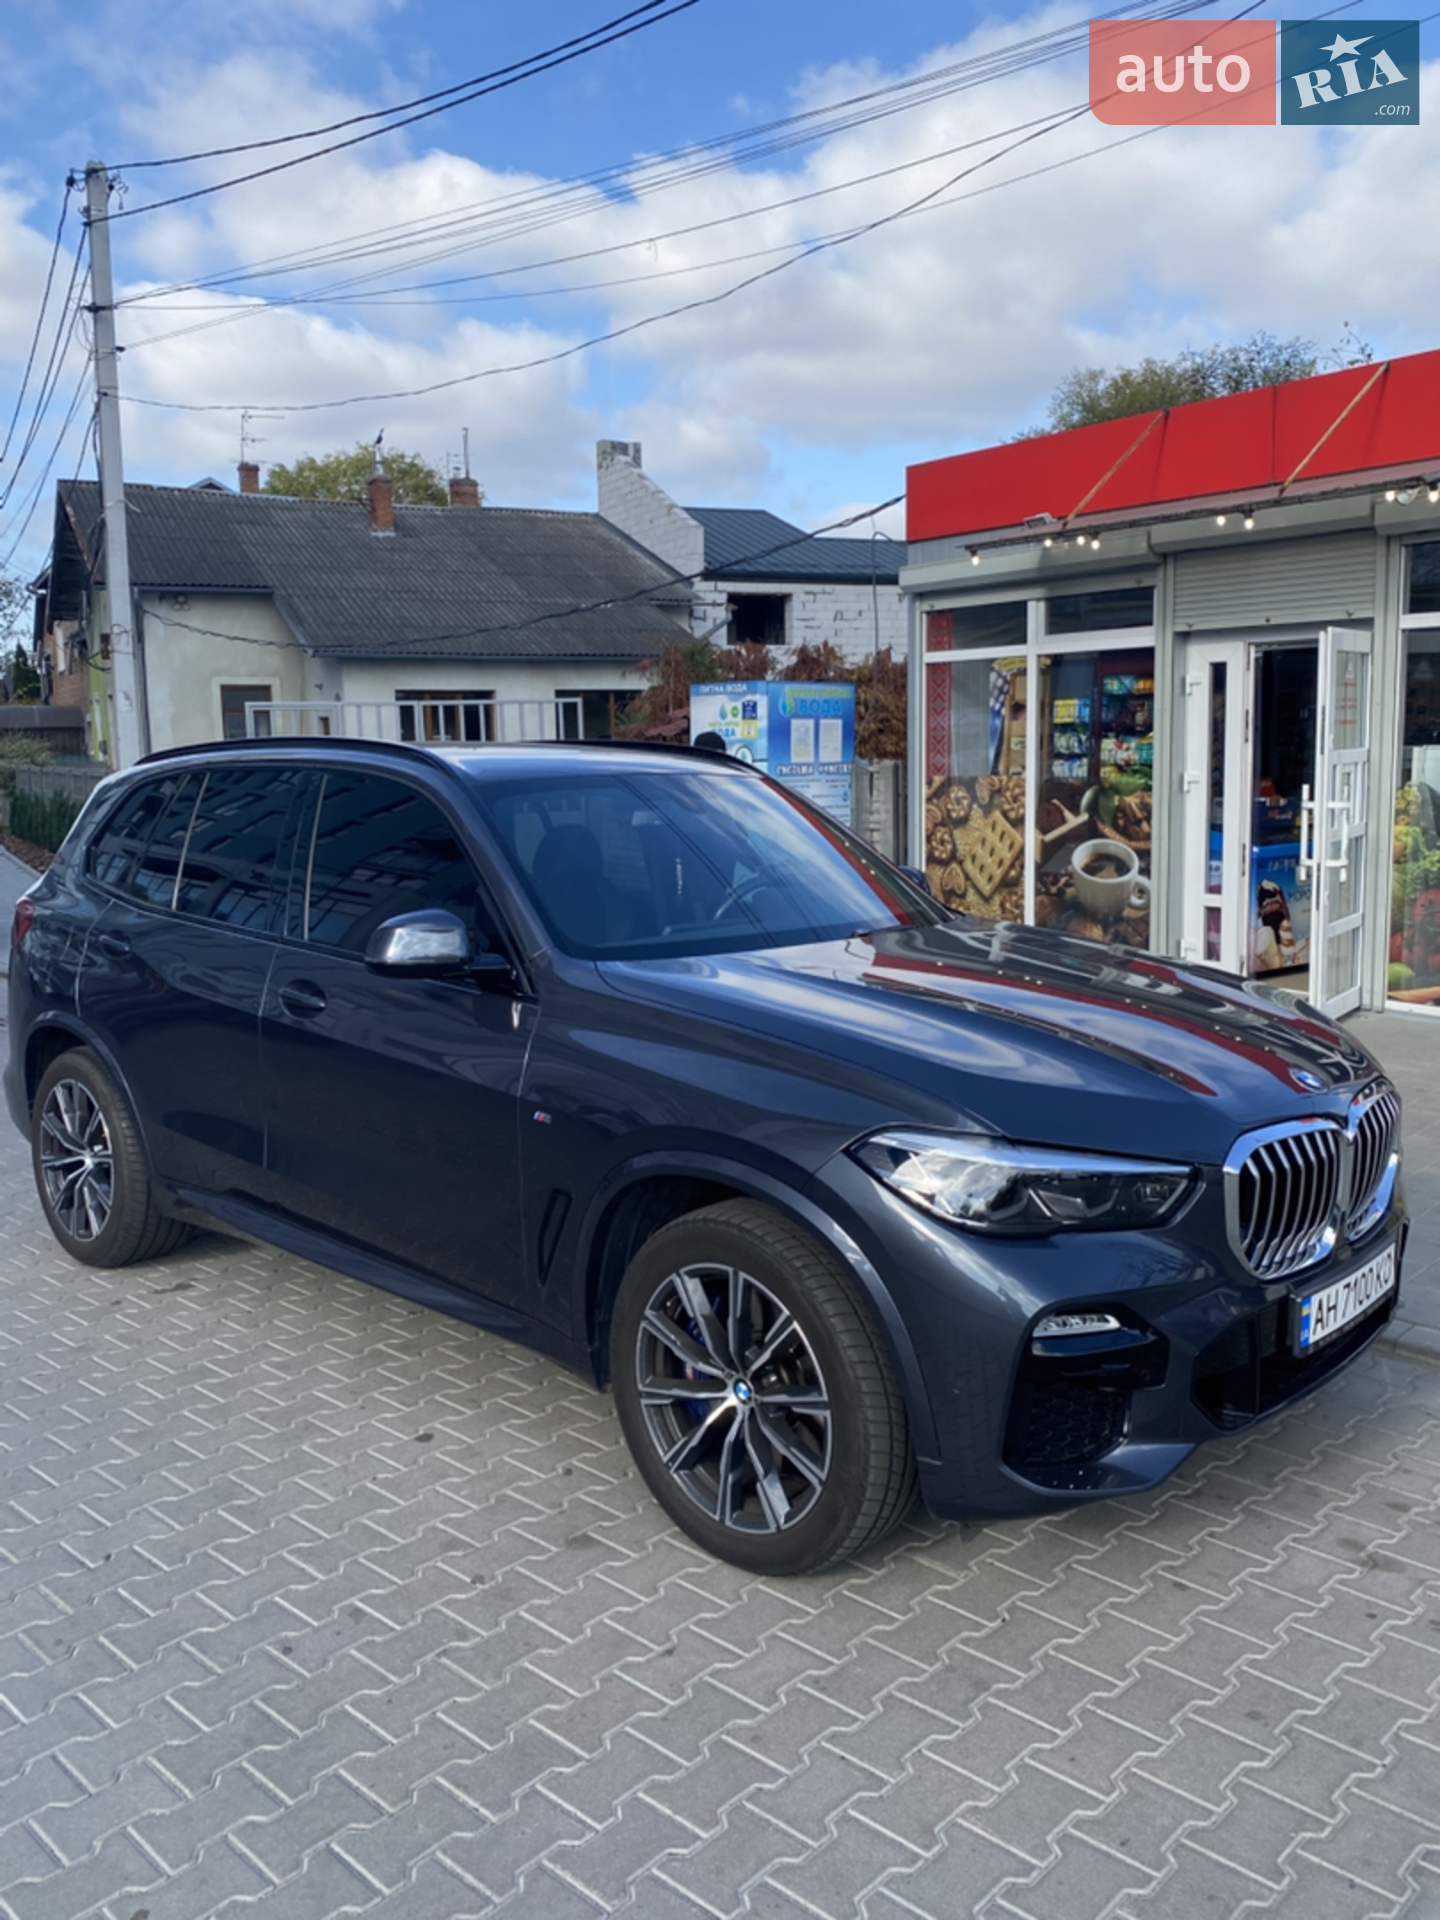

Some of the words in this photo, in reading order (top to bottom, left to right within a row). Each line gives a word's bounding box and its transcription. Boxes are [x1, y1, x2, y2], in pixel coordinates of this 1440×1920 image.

[726, 684, 747, 693] ВОДА
[800, 700, 842, 714] ВОДА
[1312, 1288, 1339, 1336] AH
[1342, 1266, 1374, 1318] 7100
